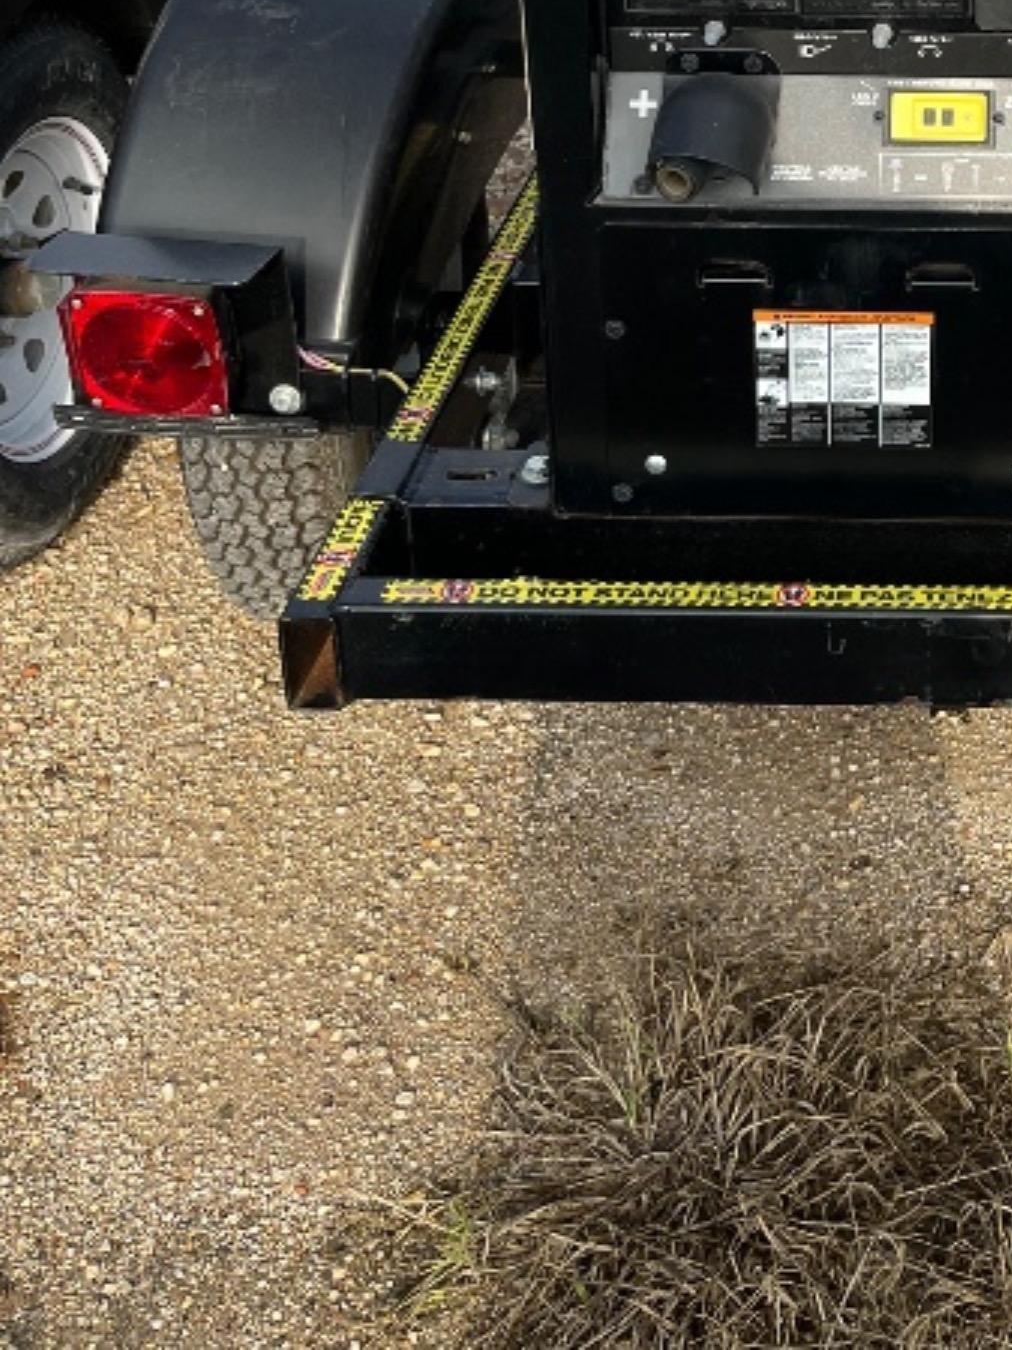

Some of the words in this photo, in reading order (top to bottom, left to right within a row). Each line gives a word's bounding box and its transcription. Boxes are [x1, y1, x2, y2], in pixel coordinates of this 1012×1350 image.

[477, 584, 521, 600] DO
[527, 585, 588, 600] NOT
[595, 585, 690, 601] STAND
